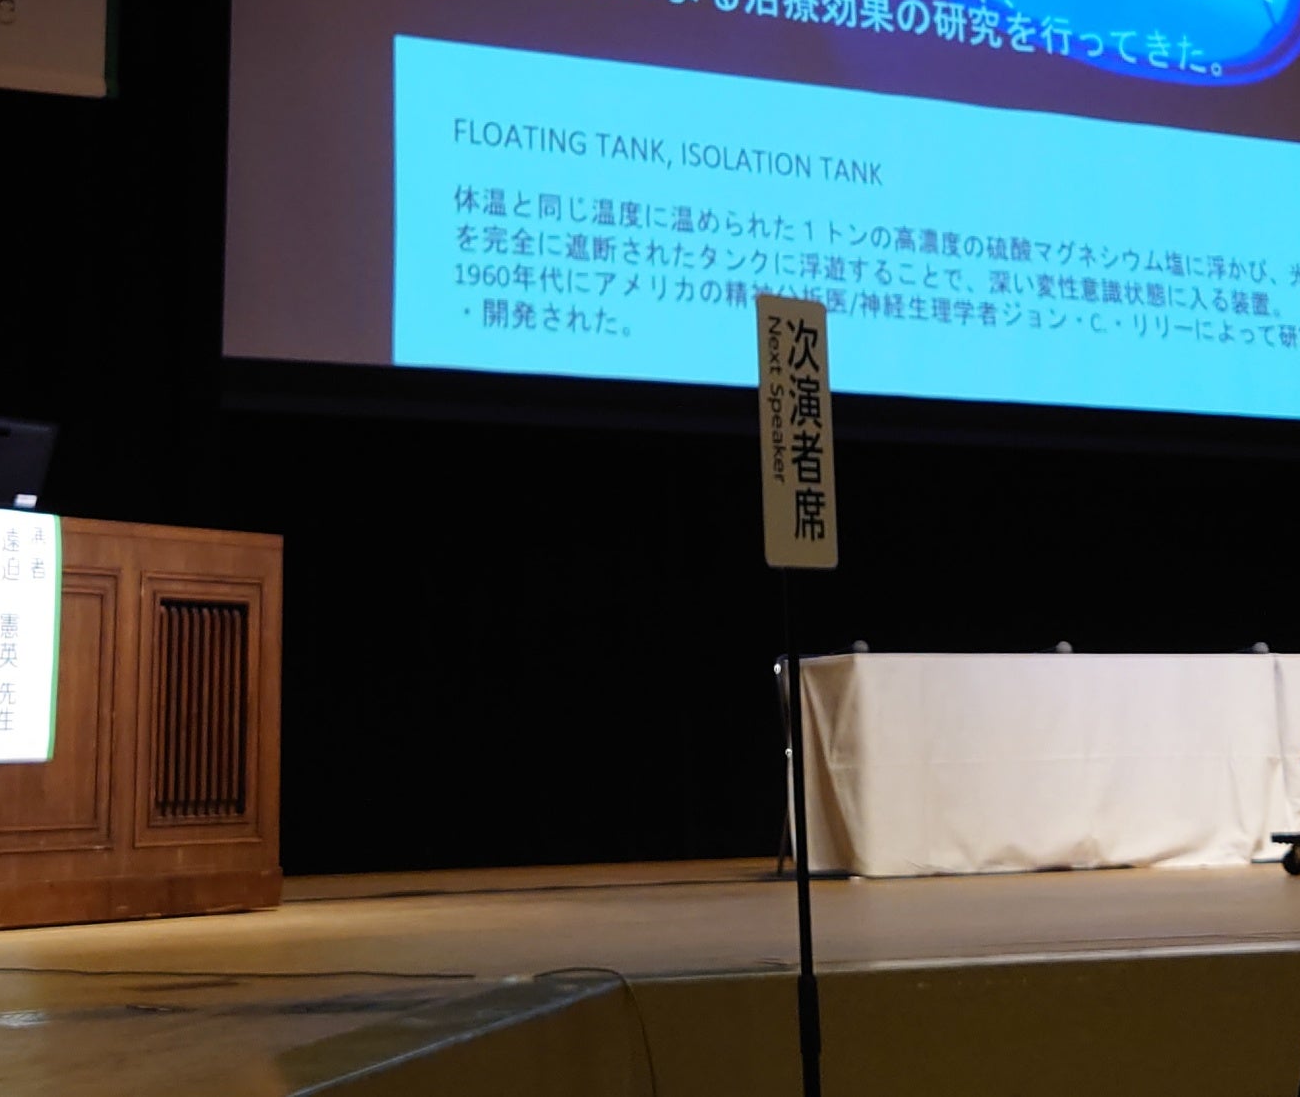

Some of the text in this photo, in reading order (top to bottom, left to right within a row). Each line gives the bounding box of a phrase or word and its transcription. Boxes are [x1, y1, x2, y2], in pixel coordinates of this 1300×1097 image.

[454, 118, 882, 186] FLOATING TANK, ISOLATION TANK
[767, 315, 785, 484] Next Speaker
[786, 318, 825, 542] 次演者席
